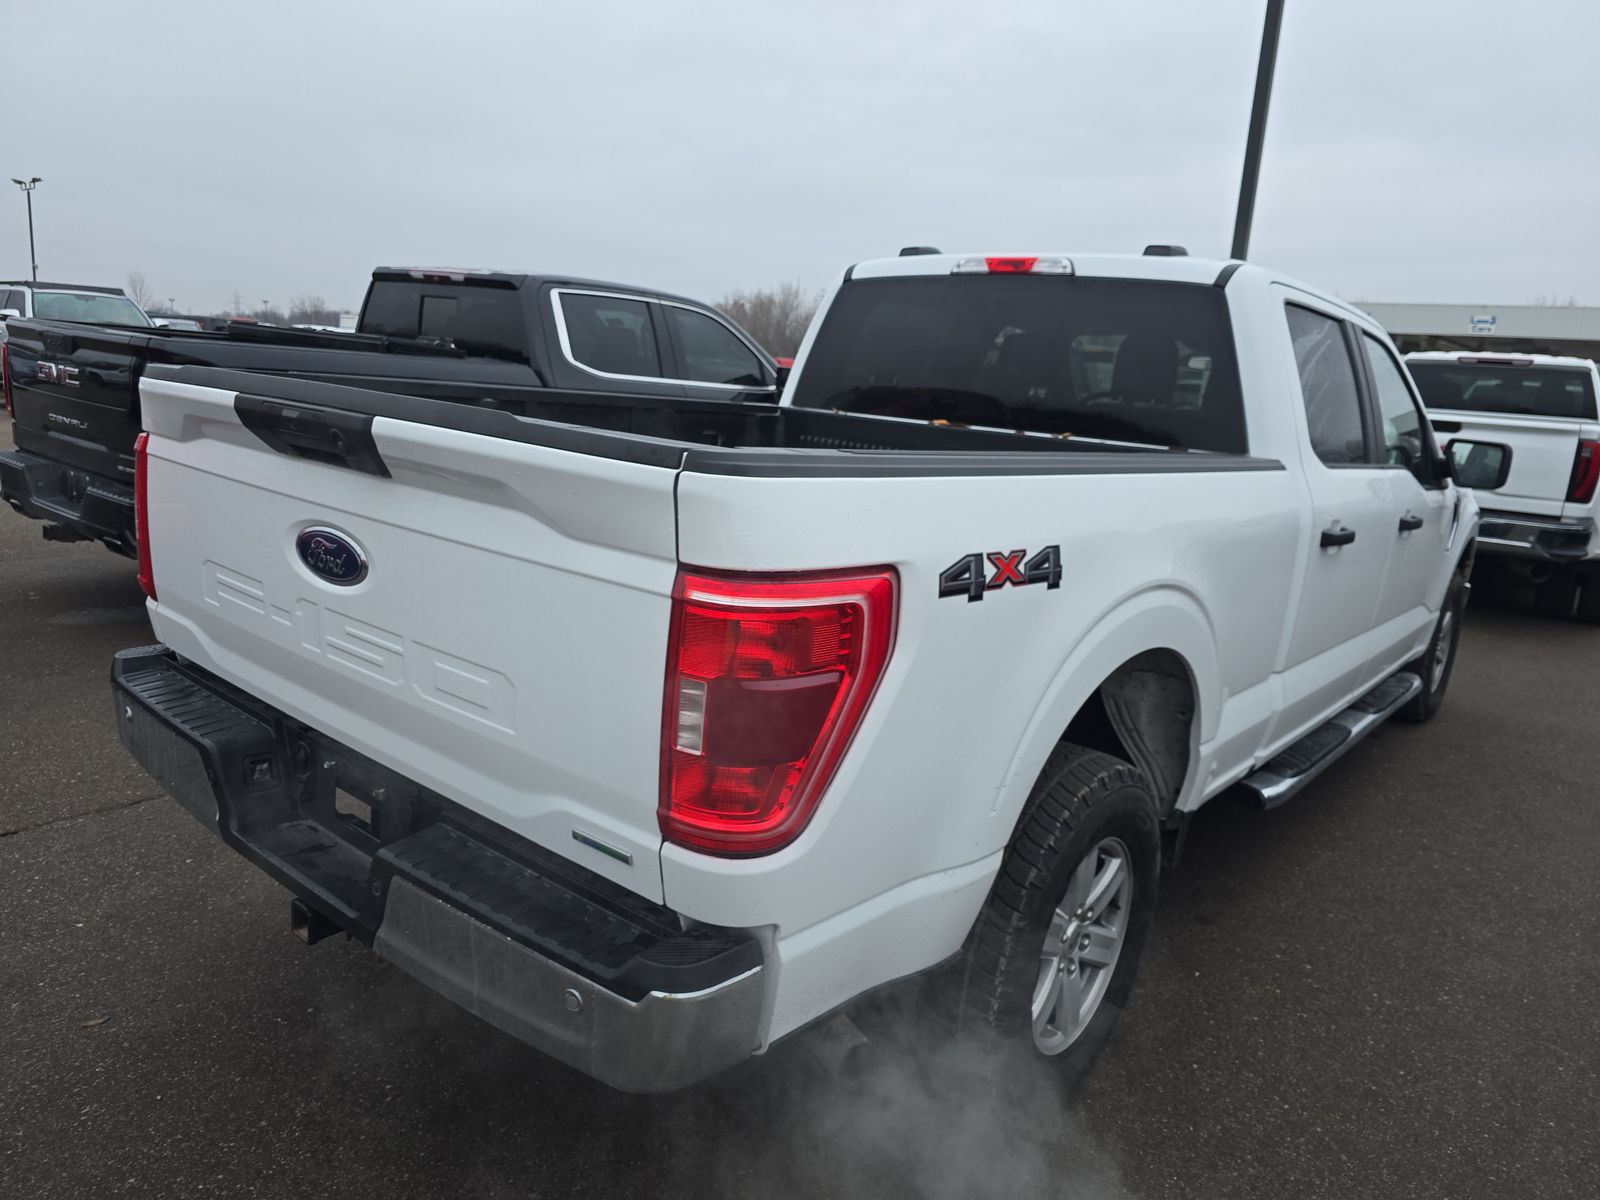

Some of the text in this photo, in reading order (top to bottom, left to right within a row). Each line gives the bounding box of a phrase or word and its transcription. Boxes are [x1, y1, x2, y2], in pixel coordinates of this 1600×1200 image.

[36, 360, 80, 388] GMC
[308, 537, 346, 575] Ford
[202, 559, 516, 735] F-150
